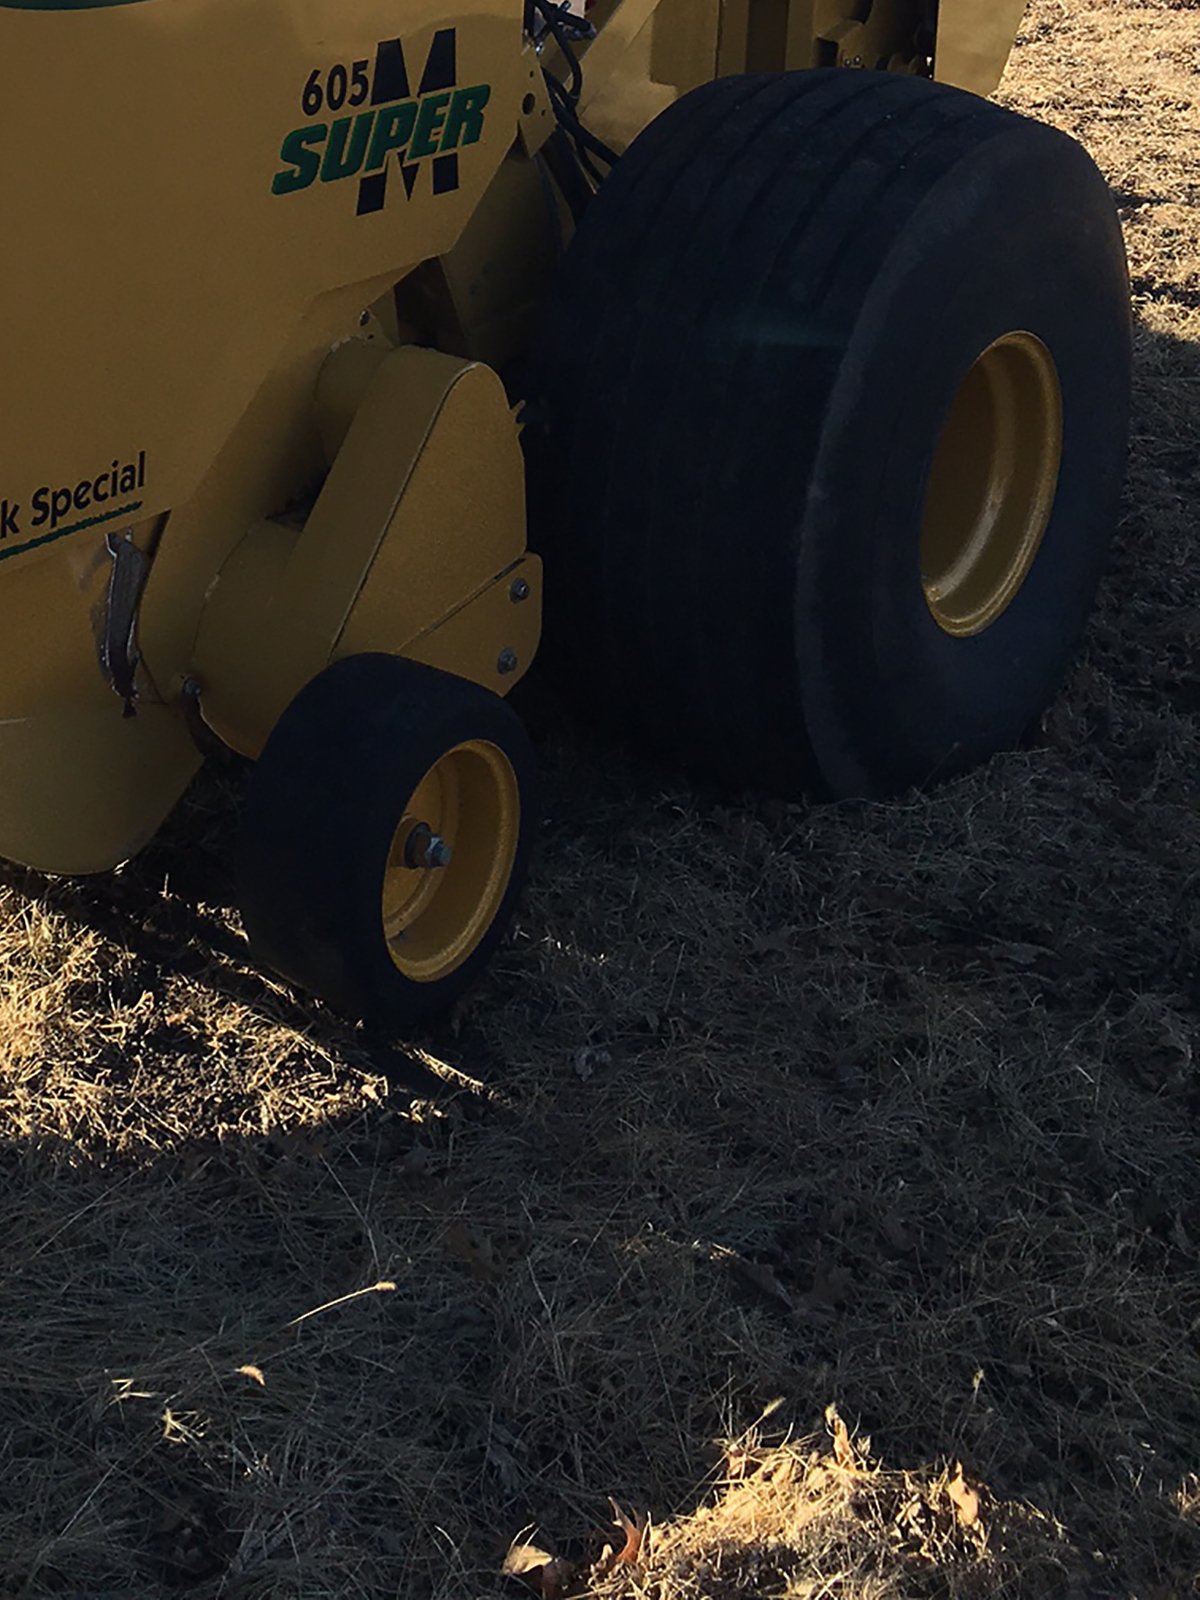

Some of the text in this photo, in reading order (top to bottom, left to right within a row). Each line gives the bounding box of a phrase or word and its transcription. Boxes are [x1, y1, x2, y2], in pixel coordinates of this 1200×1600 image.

[302, 59, 369, 116] 605
[271, 84, 491, 195] SUPER
[31, 450, 146, 528] Special
